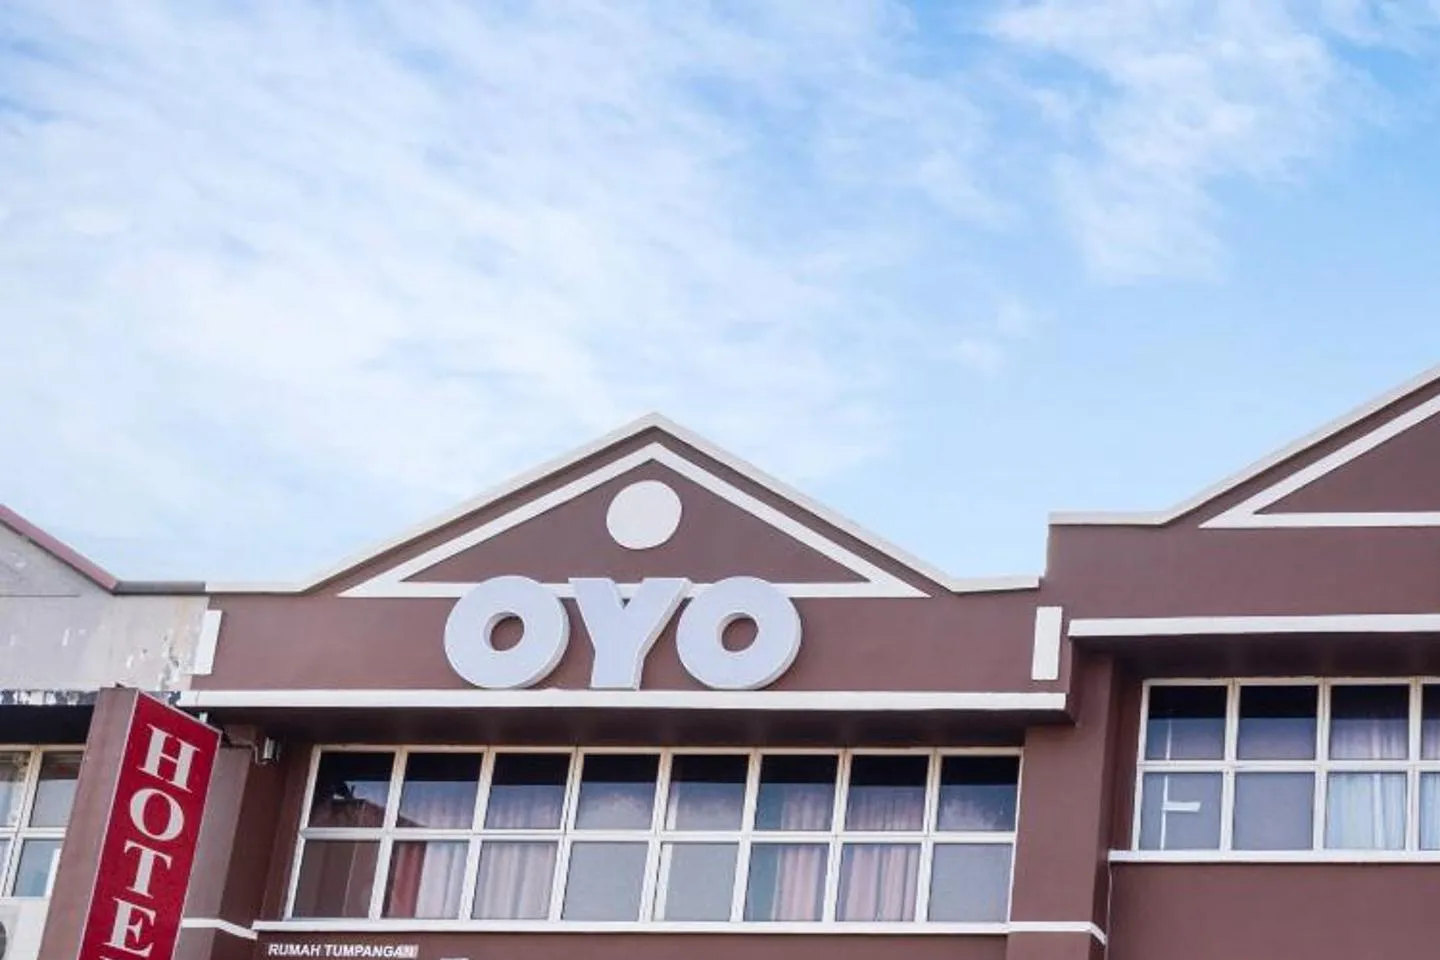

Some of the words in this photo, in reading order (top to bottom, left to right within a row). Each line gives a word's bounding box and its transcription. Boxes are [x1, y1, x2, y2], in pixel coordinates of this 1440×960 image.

[444, 575, 803, 690] OYO
[268, 944, 320, 957] RUMAH
[324, 944, 419, 959] TUMPANGAN
